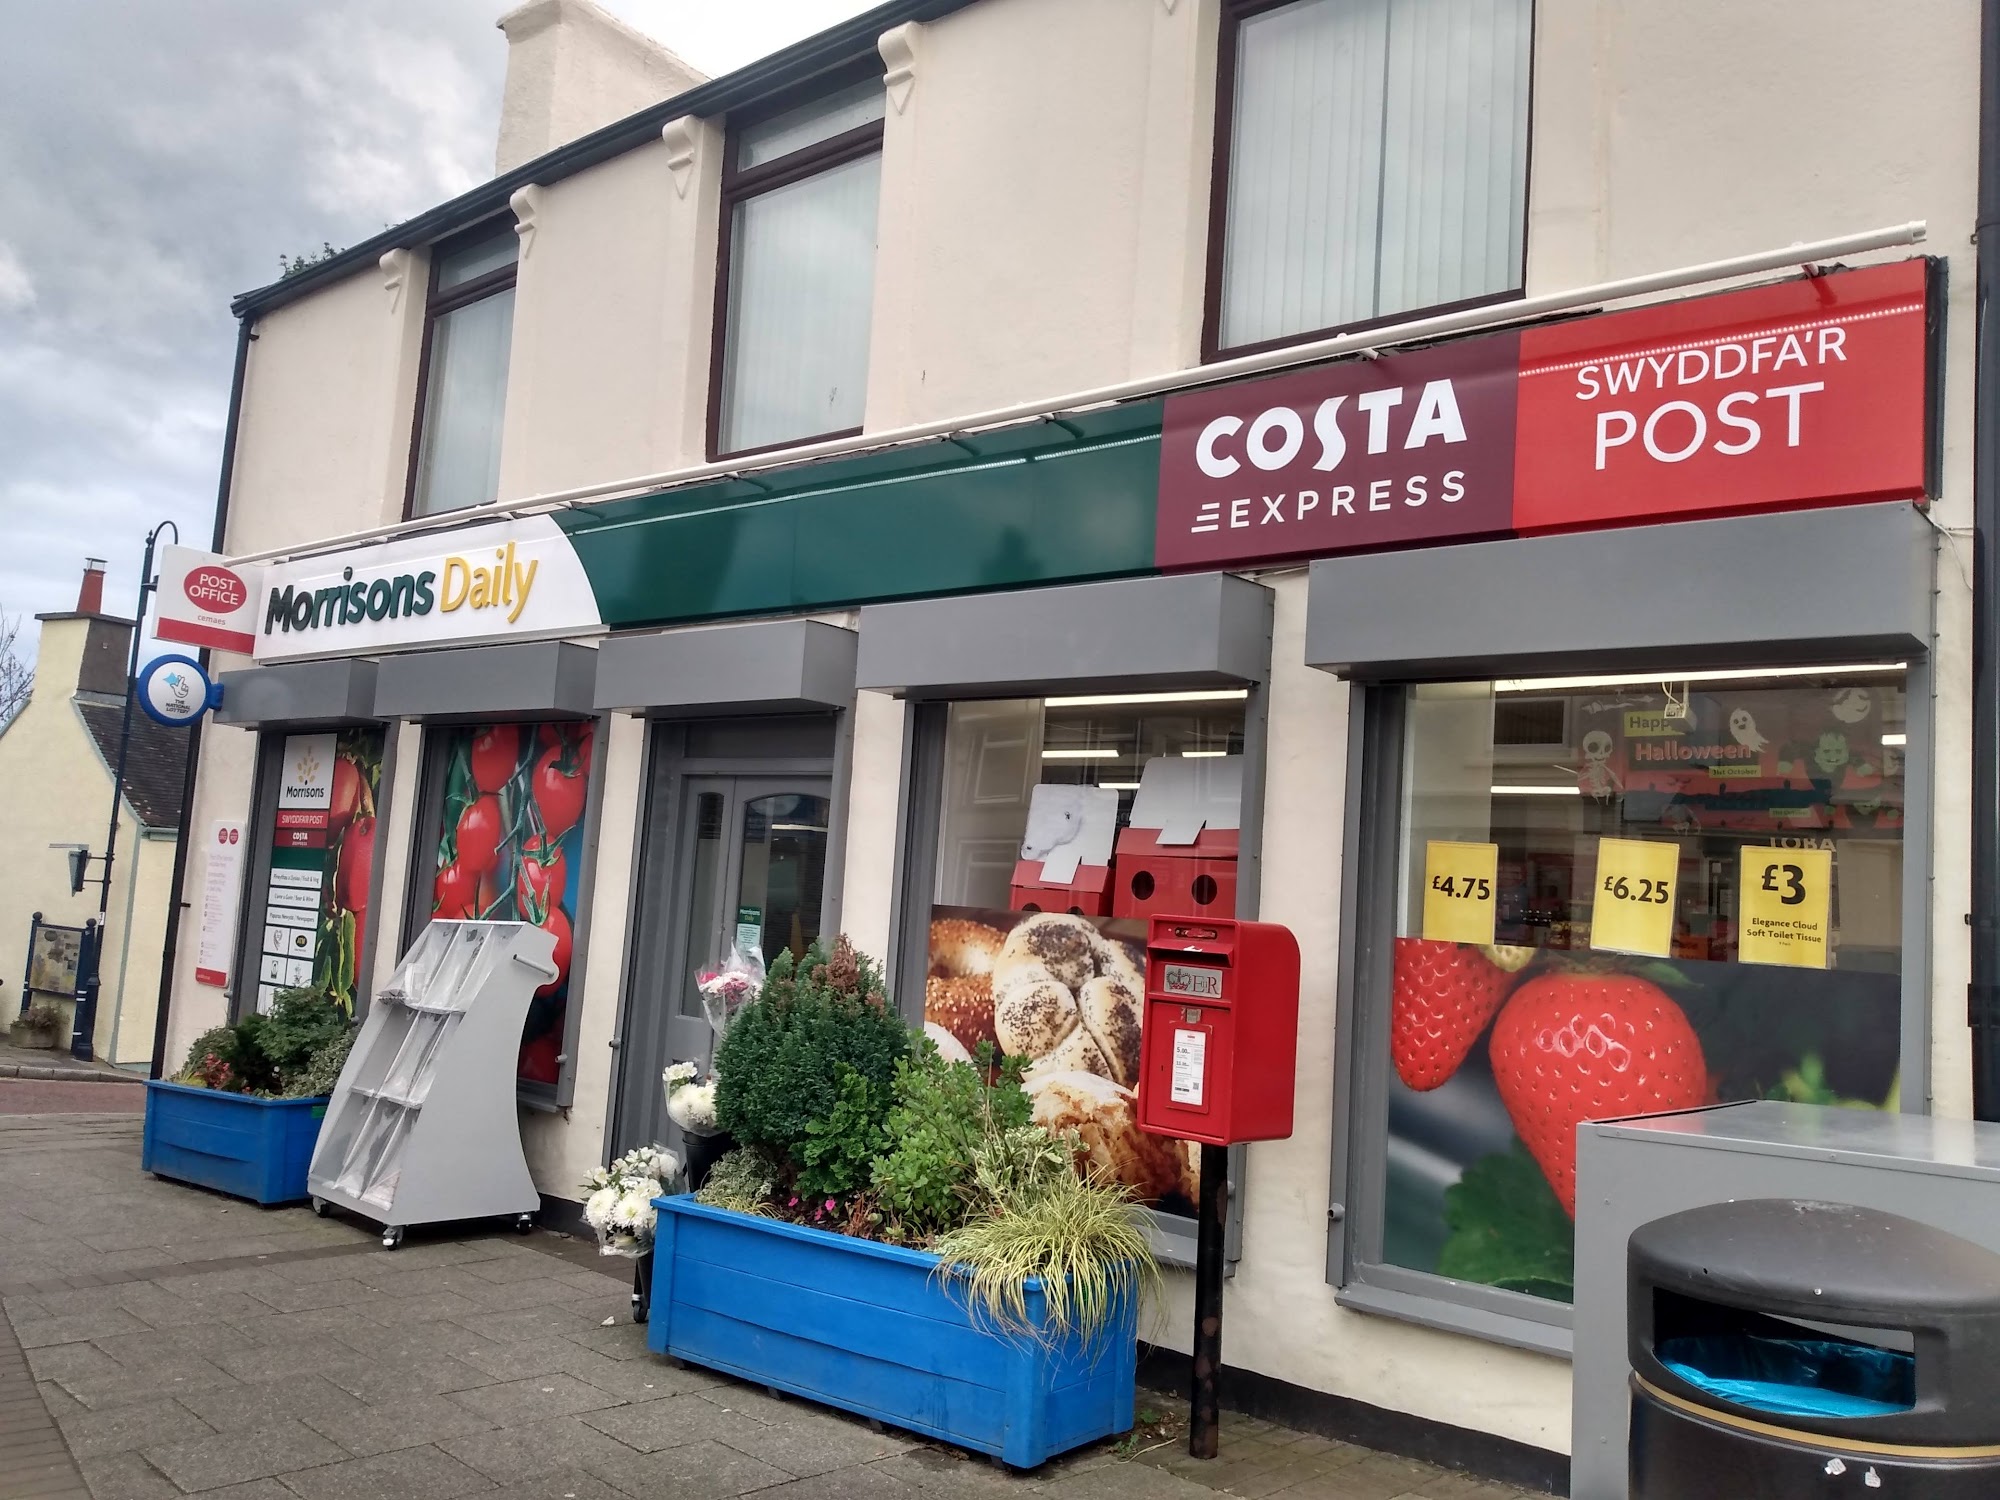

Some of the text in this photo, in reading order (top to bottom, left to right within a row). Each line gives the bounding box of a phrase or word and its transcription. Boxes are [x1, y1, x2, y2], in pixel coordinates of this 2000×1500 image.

[1576, 327, 1847, 400] SWYDDFA'R
[1195, 378, 1467, 478] COSTA
[1595, 381, 1825, 470] POST
[1230, 470, 1465, 528] EXPRESS
[199, 573, 236, 591] POST
[264, 540, 539, 635] Morrisons Daily
[189, 585, 239, 606] OFFICE
[197, 614, 226, 626] cemaes
[1629, 715, 1671, 731] Happ
[1635, 740, 1751, 761] Halloween
[1712, 768, 1757, 776] 31st October
[286, 780, 325, 798] Morrisons
[309, 815, 324, 825] POST
[292, 832, 308, 841] COSTA
[1432, 875, 1490, 900] £4.75
[1604, 876, 1669, 904] £6.25
[1761, 864, 1806, 905] £3
[1752, 917, 1818, 931] Elegance Cloud
[1746, 928, 1822, 943] Soft Toilet Tissue
